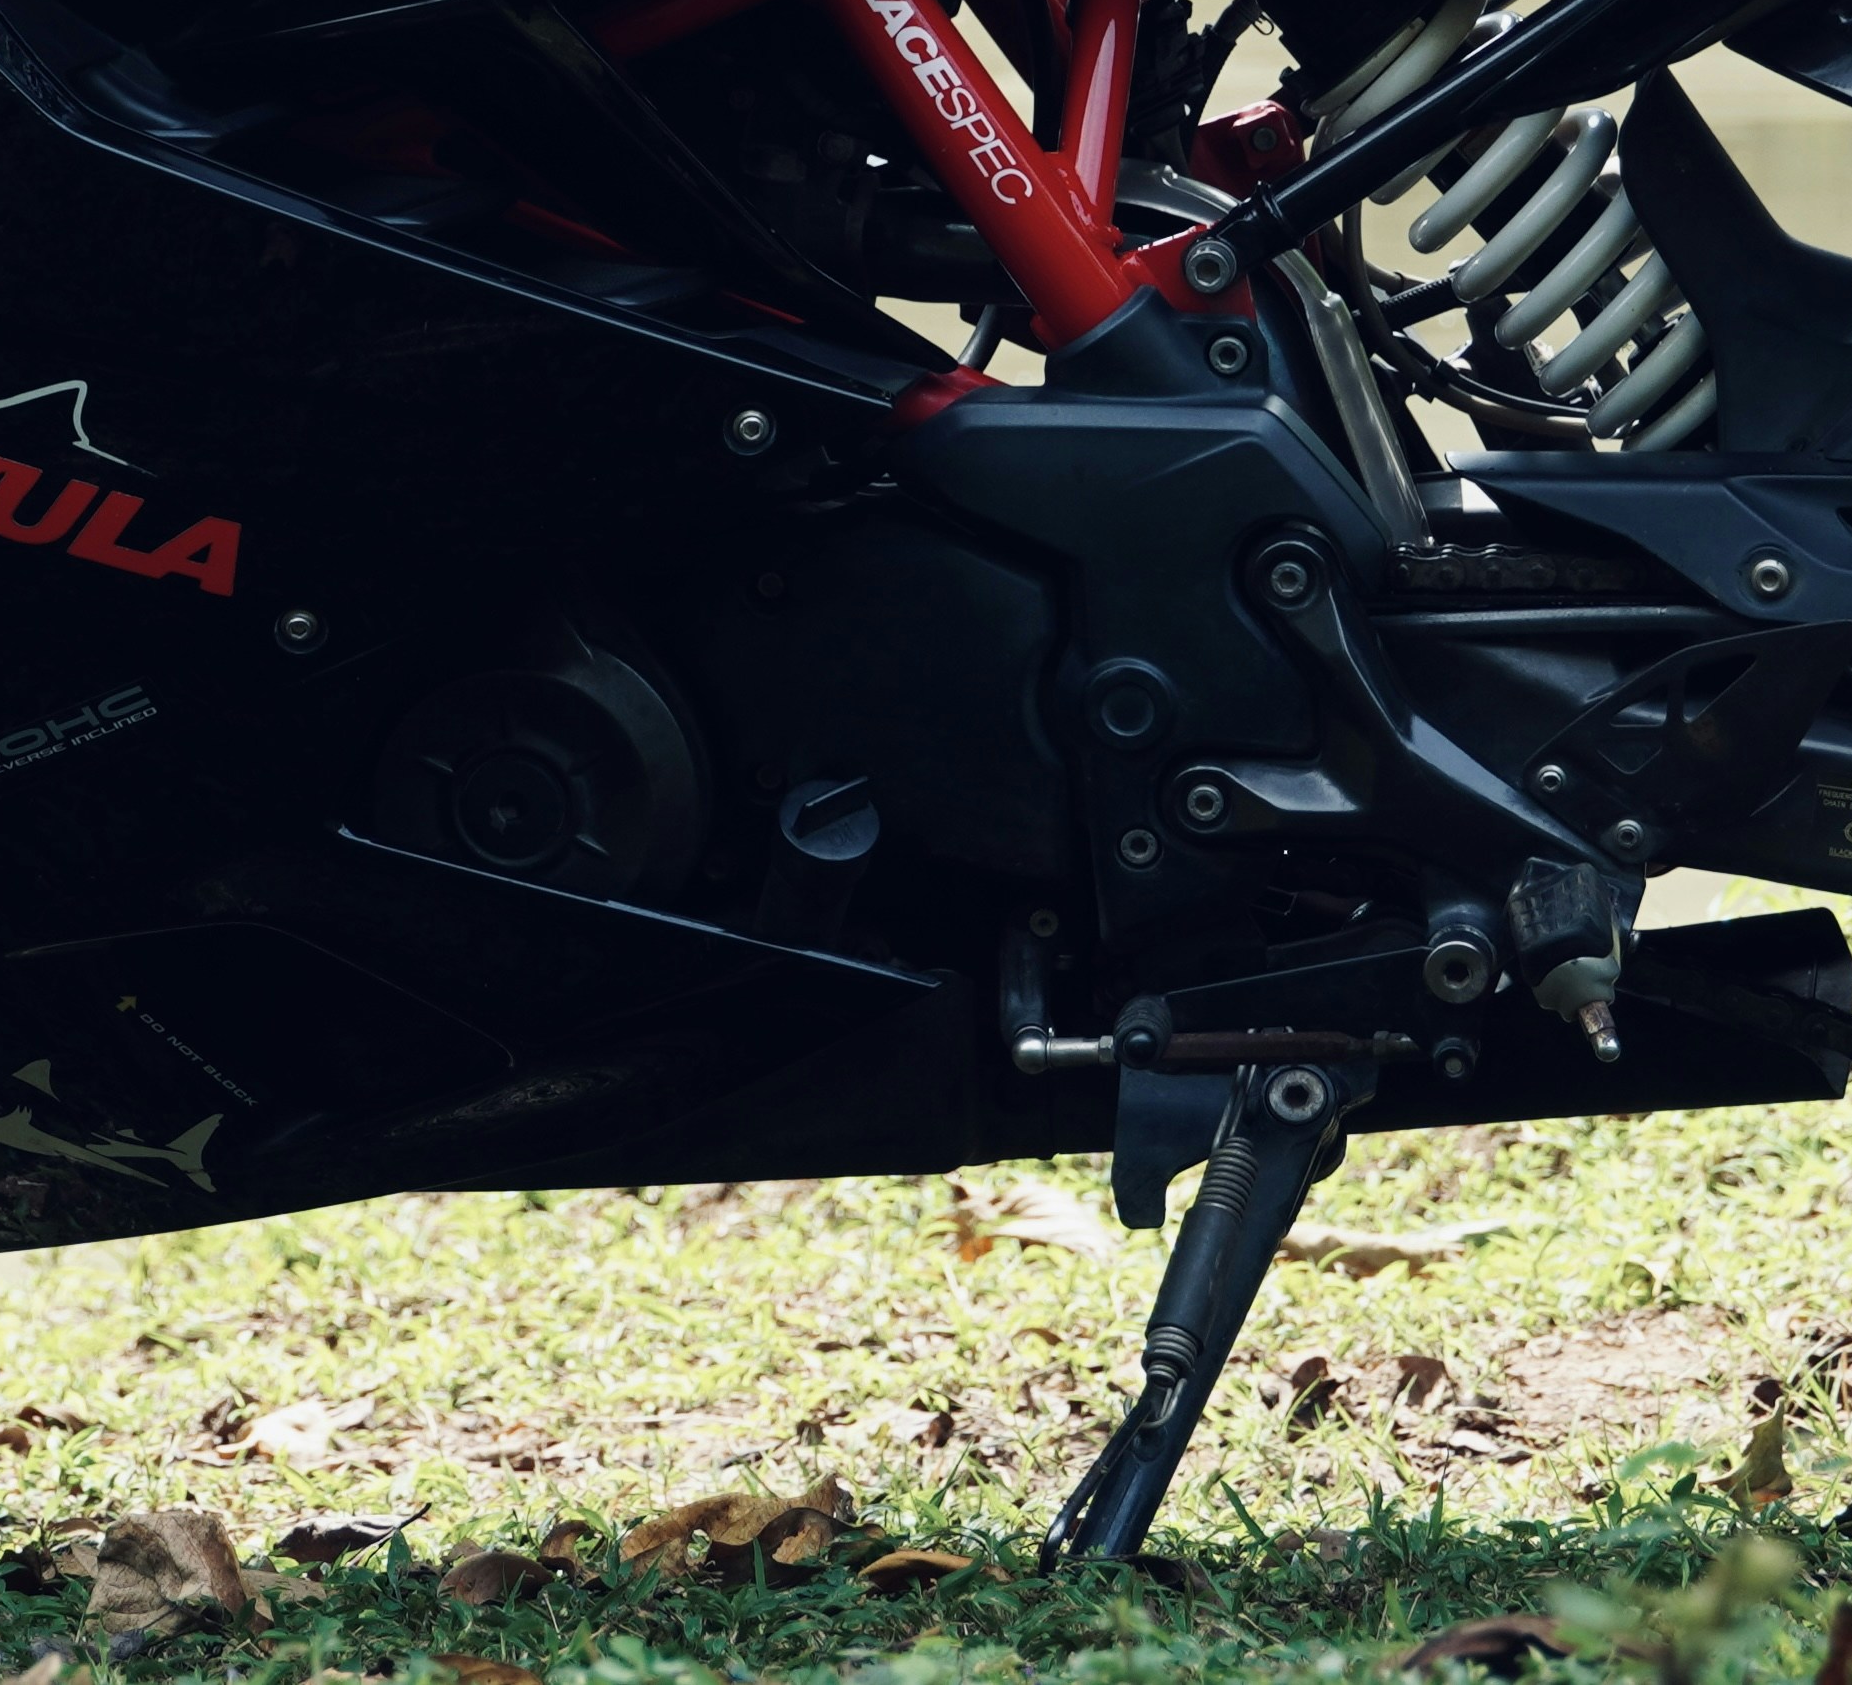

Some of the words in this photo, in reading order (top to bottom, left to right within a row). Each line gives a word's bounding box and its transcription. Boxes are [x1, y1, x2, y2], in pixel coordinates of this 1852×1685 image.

[70, 706, 158, 746] INCLINED
[139, 1013, 166, 1034] DO
[167, 1035, 204, 1062] NOT
[202, 1064, 259, 1106] BLOCK
